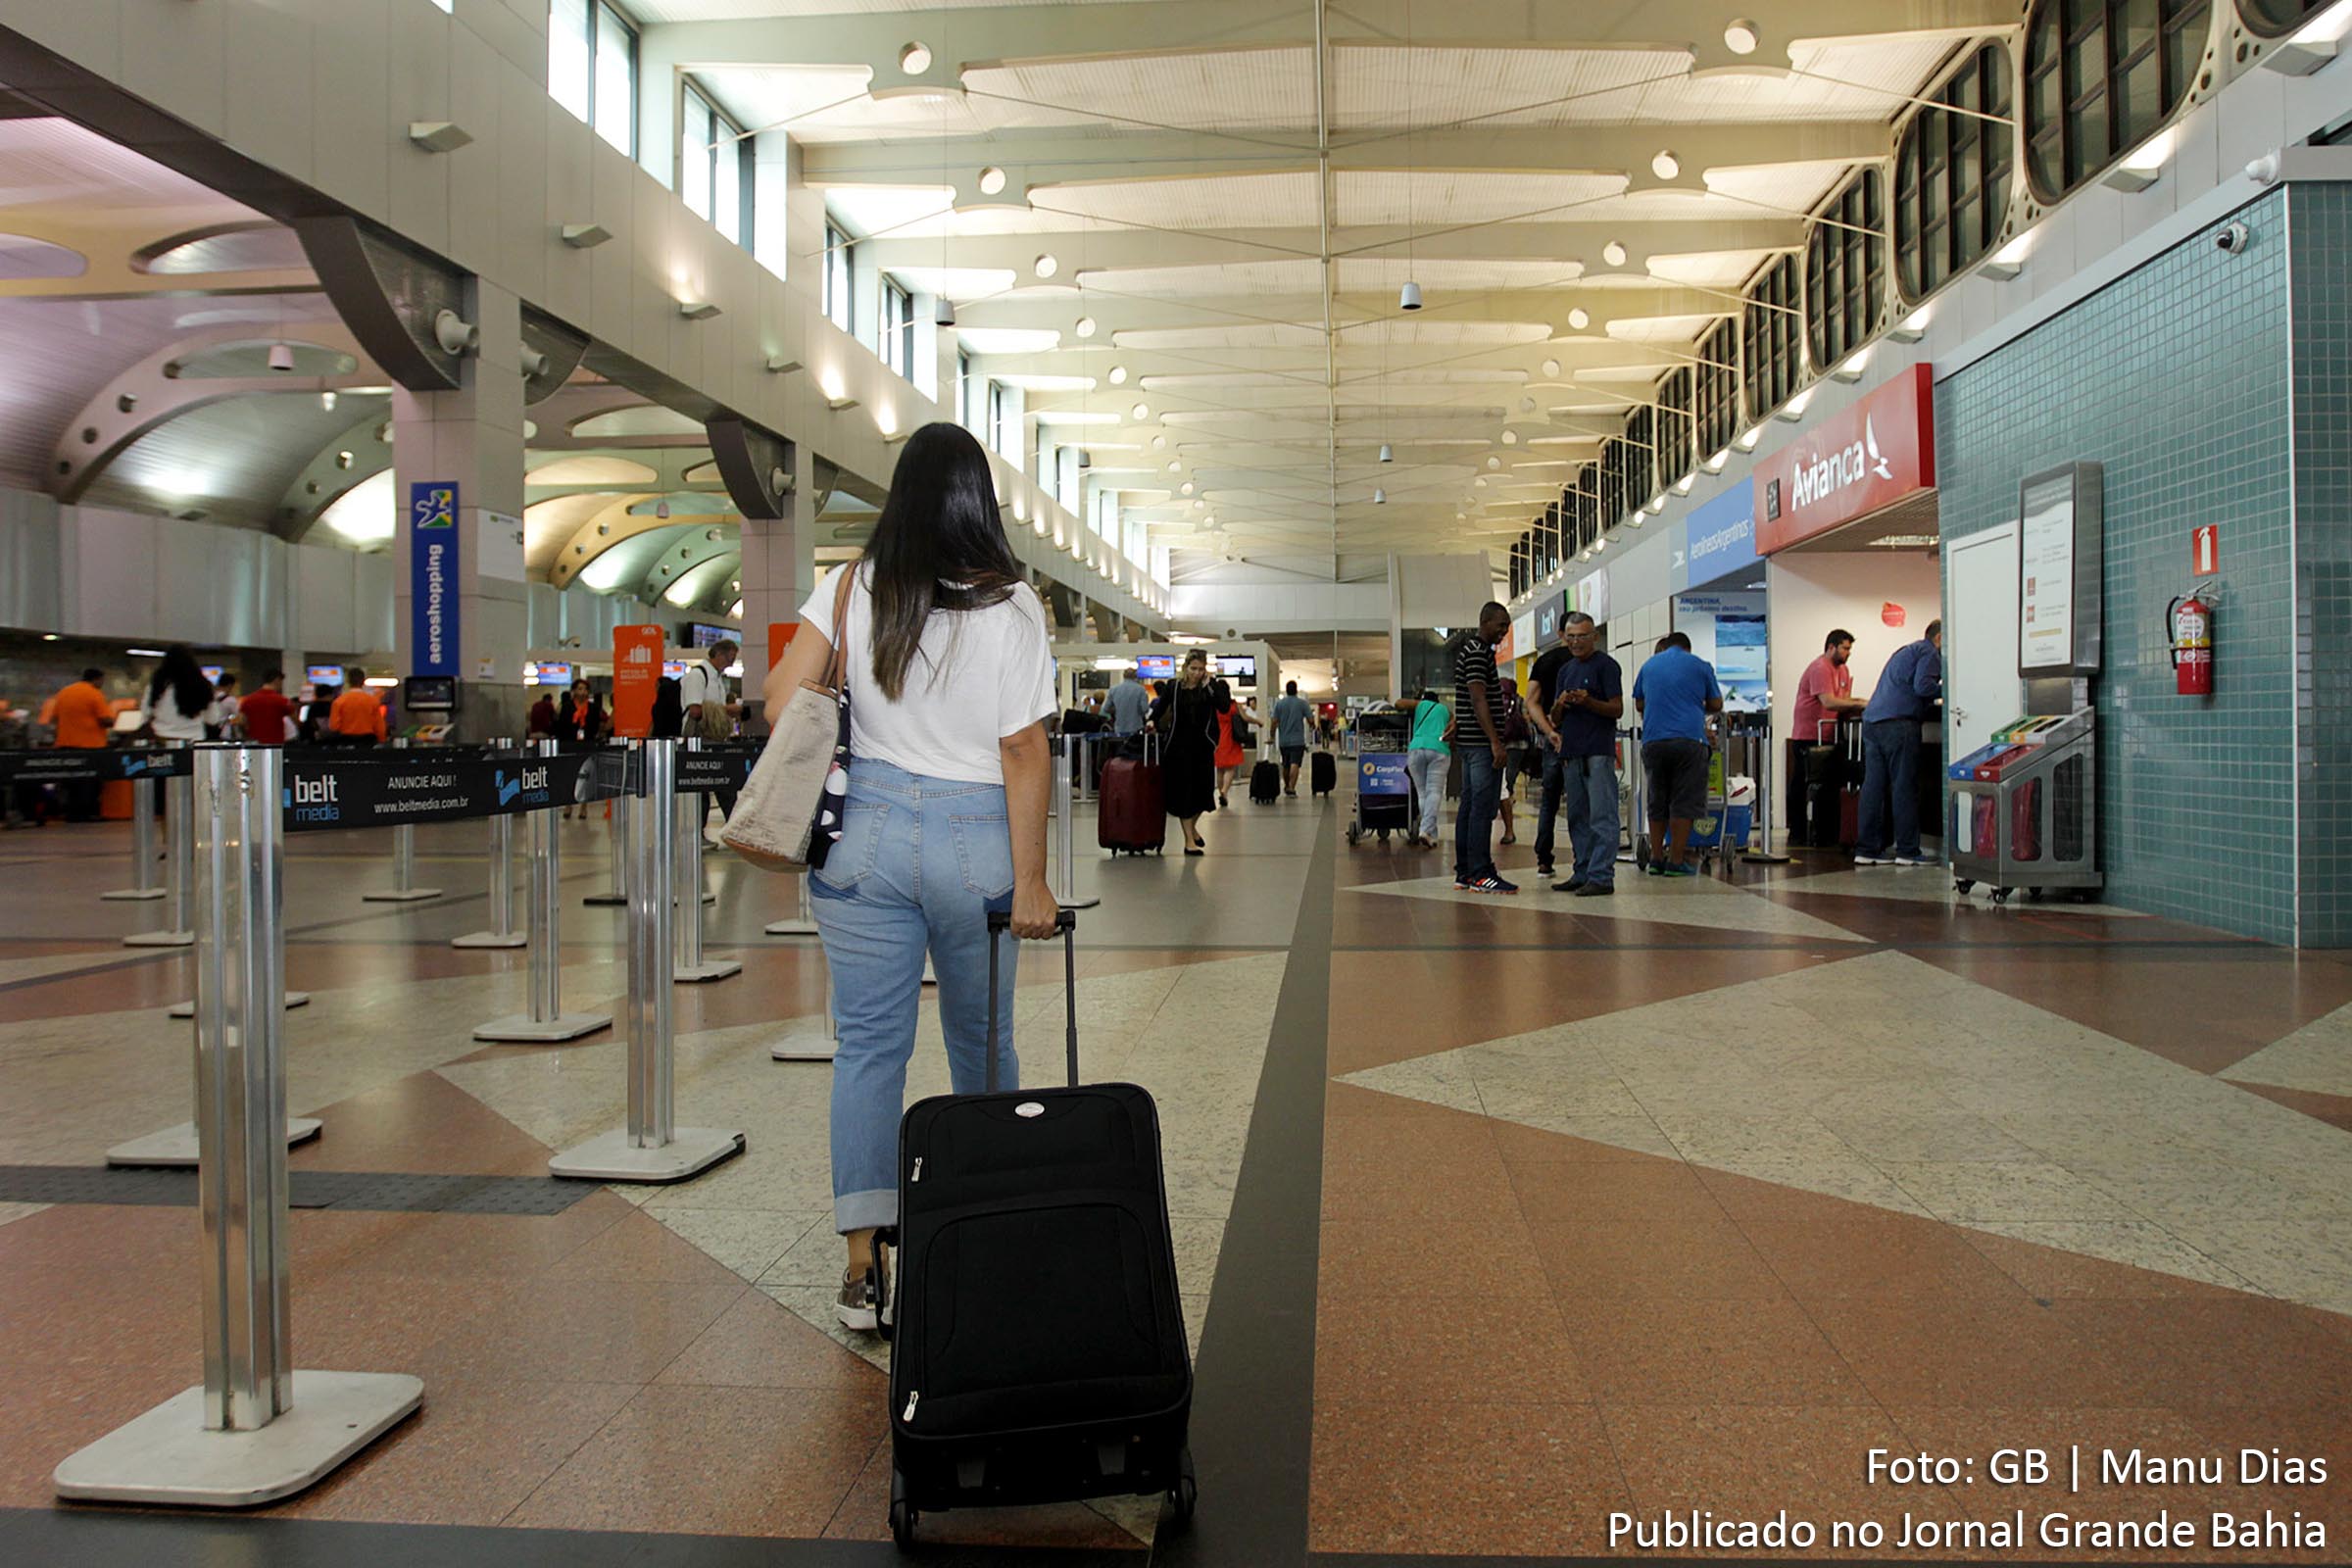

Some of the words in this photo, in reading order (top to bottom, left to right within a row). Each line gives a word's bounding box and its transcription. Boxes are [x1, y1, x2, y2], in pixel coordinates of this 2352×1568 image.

[1791, 440, 1865, 512] Avianca
[425, 544, 444, 663] aeroshopping
[148, 754, 173, 767] belt
[387, 775, 429, 790] ANUNCIE
[522, 766, 548, 790] belt
[294, 774, 339, 804] belt
[522, 788, 549, 804] media
[296, 804, 340, 822] media
[374, 796, 468, 814] www.beltmedia.com.br
